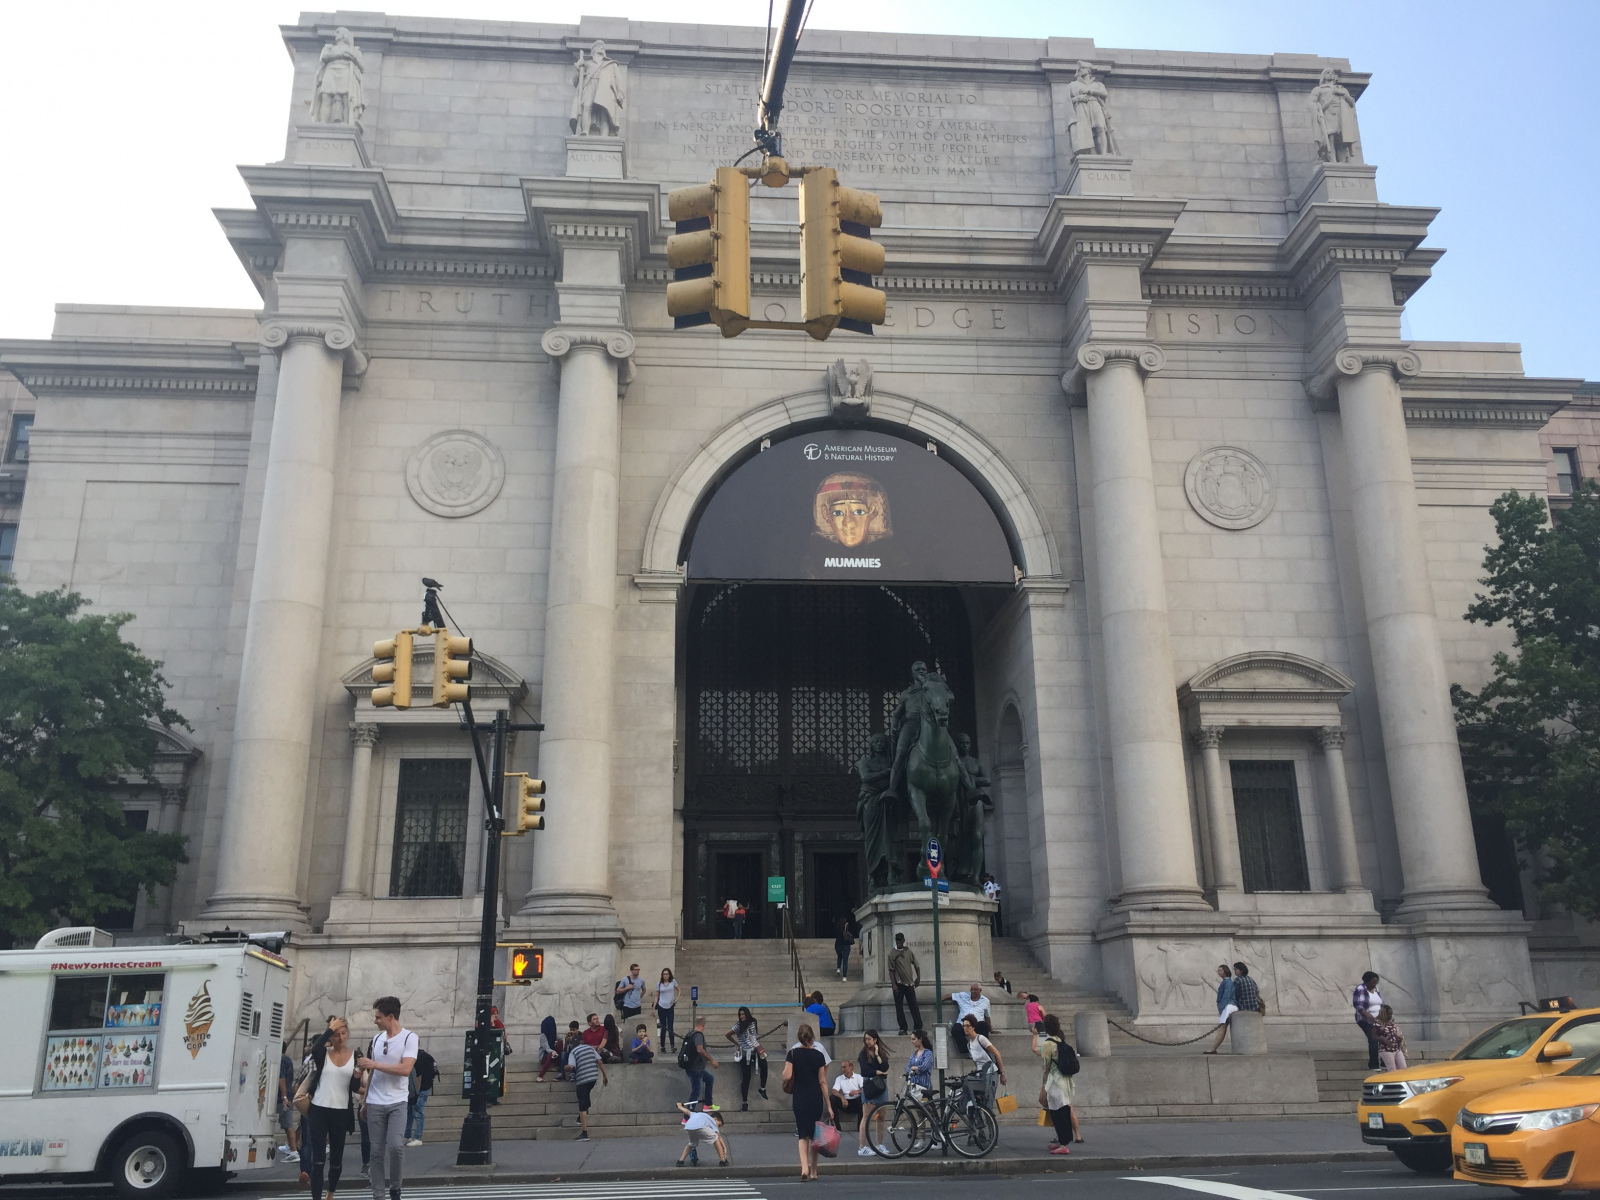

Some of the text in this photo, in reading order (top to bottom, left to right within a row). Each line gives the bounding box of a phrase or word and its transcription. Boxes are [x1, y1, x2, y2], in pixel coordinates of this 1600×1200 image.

[704, 83, 749, 96] STATE
[784, 87, 816, 98] NEW
[824, 88, 865, 101] YORK
[872, 90, 952, 104] MEMORIAL
[956, 93, 977, 105] TO
[738, 98, 945, 118] THDORE ROOSEVELT
[700, 111, 745, 122] GREAT
[752, 113, 802, 124] LDER
[807, 115, 824, 125] OF
[832, 116, 856, 127] THE
[863, 118, 909, 128] YOUTH
[916, 120, 932, 129] OF
[938, 121, 997, 132] AMERICA
[654, 121, 1028, 144] IN ENERGY AND RTITUDE IN THE FAITH OF OUR FATHERS
[695, 134, 709, 143] IN
[717, 135, 757, 145] DEFEN
[801, 138, 826, 148] THE
[834, 140, 882, 150] RIGHTS
[888, 142, 905, 151] OF
[910, 142, 935, 152] THE
[942, 144, 988, 154] PEOPLE
[569, 152, 620, 163] AUDUBON
[683, 145, 696, 154] IN
[701, 146, 729, 155] THE
[785, 150, 805, 158] ND
[812, 150, 917, 163] CONSERVATION
[924, 154, 940, 164] OF
[947, 155, 1001, 166] NATURE
[838, 163, 851, 173] IN
[859, 164, 885, 174] LIFE
[891, 165, 920, 175] AND
[926, 166, 940, 176] IN
[947, 167, 976, 176] MAN
[1087, 172, 1126, 182] CLARK
[1334, 180, 1370, 189] LEWIS
[380, 289, 551, 317] TRUTH
[823, 444, 898, 453] AMERICAN MUSEUM
[830, 453, 864, 461] NATURAL
[864, 453, 895, 462] HISTORY
[824, 557, 882, 569] MUMMIES
[51, 961, 162, 971] #NewYorkIceCream
[187, 1041, 207, 1050] Cone
